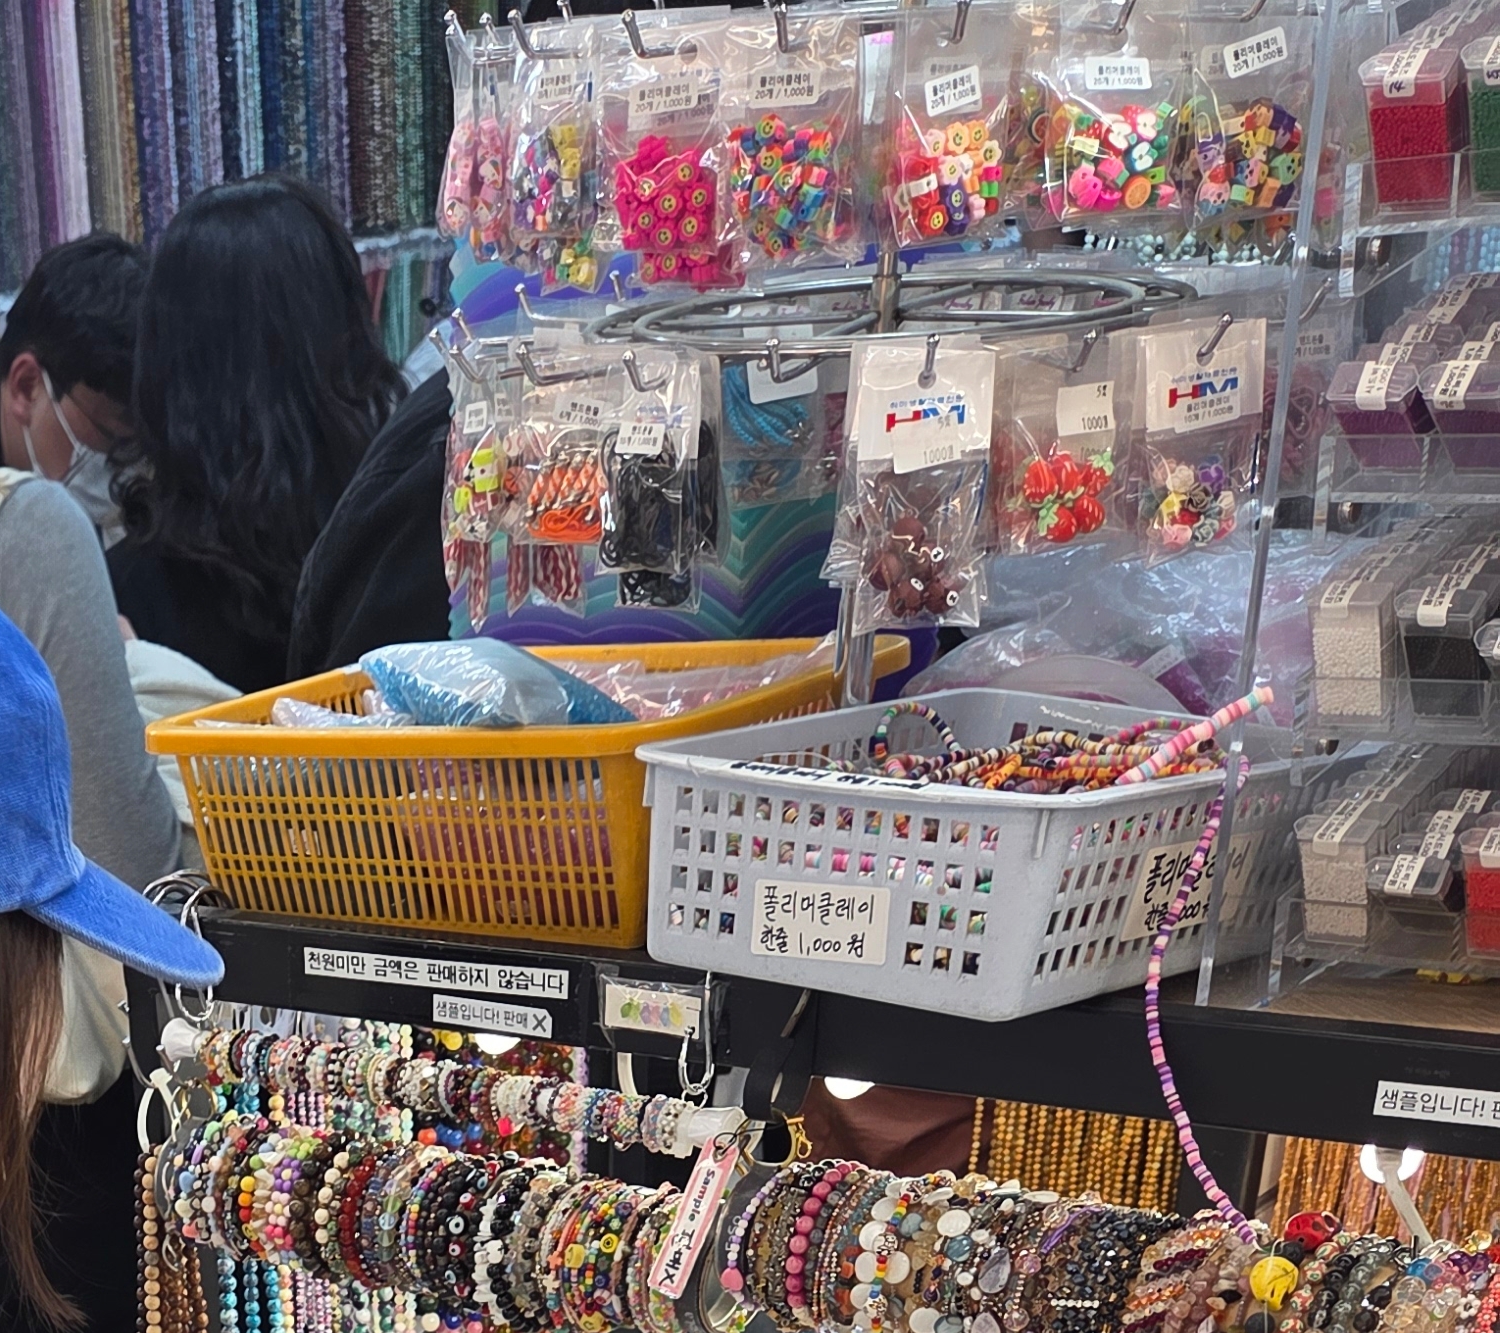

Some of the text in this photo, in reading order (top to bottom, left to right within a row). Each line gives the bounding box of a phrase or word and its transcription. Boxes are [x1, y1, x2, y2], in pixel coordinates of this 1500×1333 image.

[639, 83, 690, 101] 폴리머클레이
[760, 73, 811, 88] 폴리머클레이
[783, 85, 814, 98] 1,000원
[663, 96, 692, 108] 1,000원
[1168, 376, 1239, 408] HM
[764, 885, 875, 926] 폴리머클레이
[760, 924, 789, 954] 한줄
[307, 950, 564, 994] 천원미만 금액은 판매하지 않습니다
[435, 1000, 501, 1025] 샘플입니다!
[503, 1012, 529, 1029] 판매
[1380, 1088, 1486, 1118] 샘플입니다!
[688, 1168, 716, 1222] Sample
